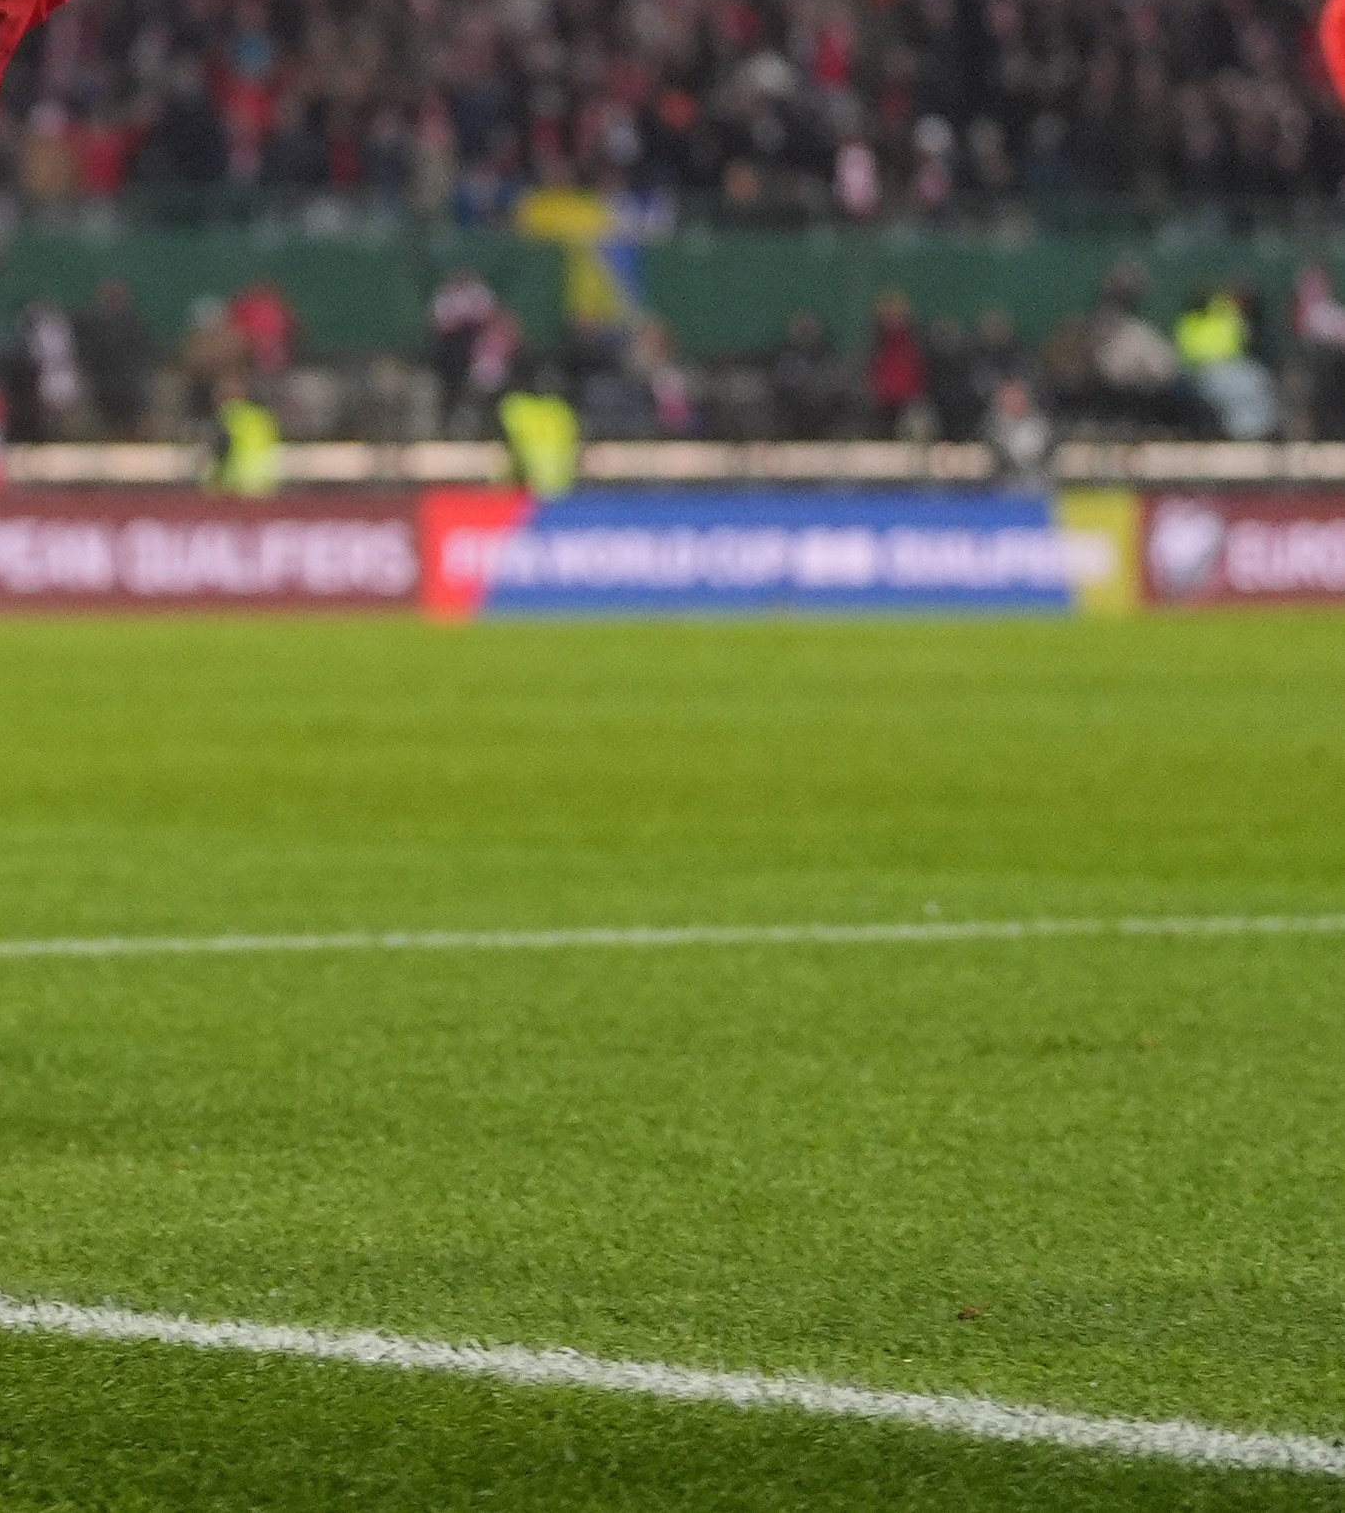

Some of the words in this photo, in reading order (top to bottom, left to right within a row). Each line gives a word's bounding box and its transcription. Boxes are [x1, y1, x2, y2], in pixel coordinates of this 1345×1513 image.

[122, 522, 414, 590] QUALIFIERS
[549, 530, 699, 585] WORLD
[706, 530, 790, 585] CUP
